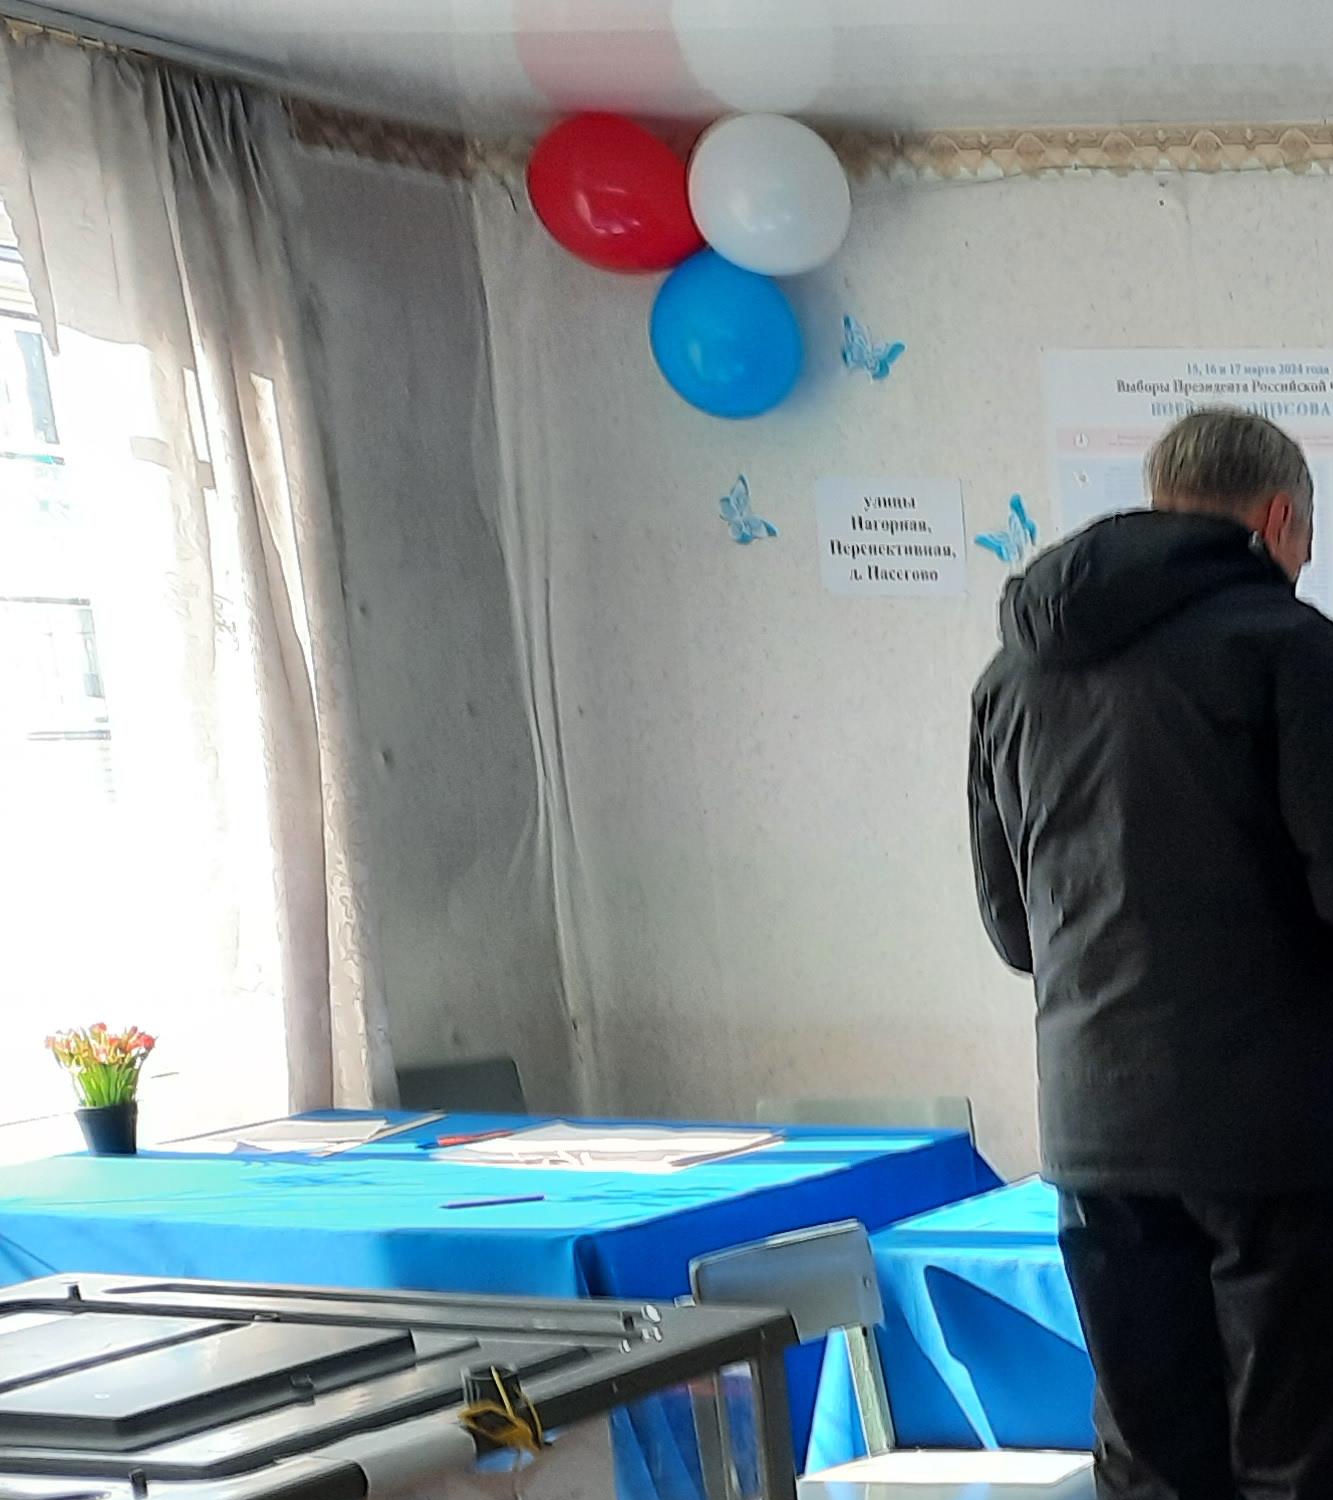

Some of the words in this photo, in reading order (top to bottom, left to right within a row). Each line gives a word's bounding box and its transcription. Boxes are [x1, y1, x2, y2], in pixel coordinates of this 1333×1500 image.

[1205, 363, 1217, 375] 16
[1230, 363, 1241, 375] 17
[1244, 365, 1276, 378] марта
[1306, 364, 1330, 376] года
[1117, 379, 1171, 396] Выборы
[1173, 379, 1249, 396] Президента
[1252, 378, 1327, 394] Российской
[864, 495, 916, 512] улицы
[851, 515, 932, 535] Нагорная,
[830, 539, 957, 560] Перспективная,
